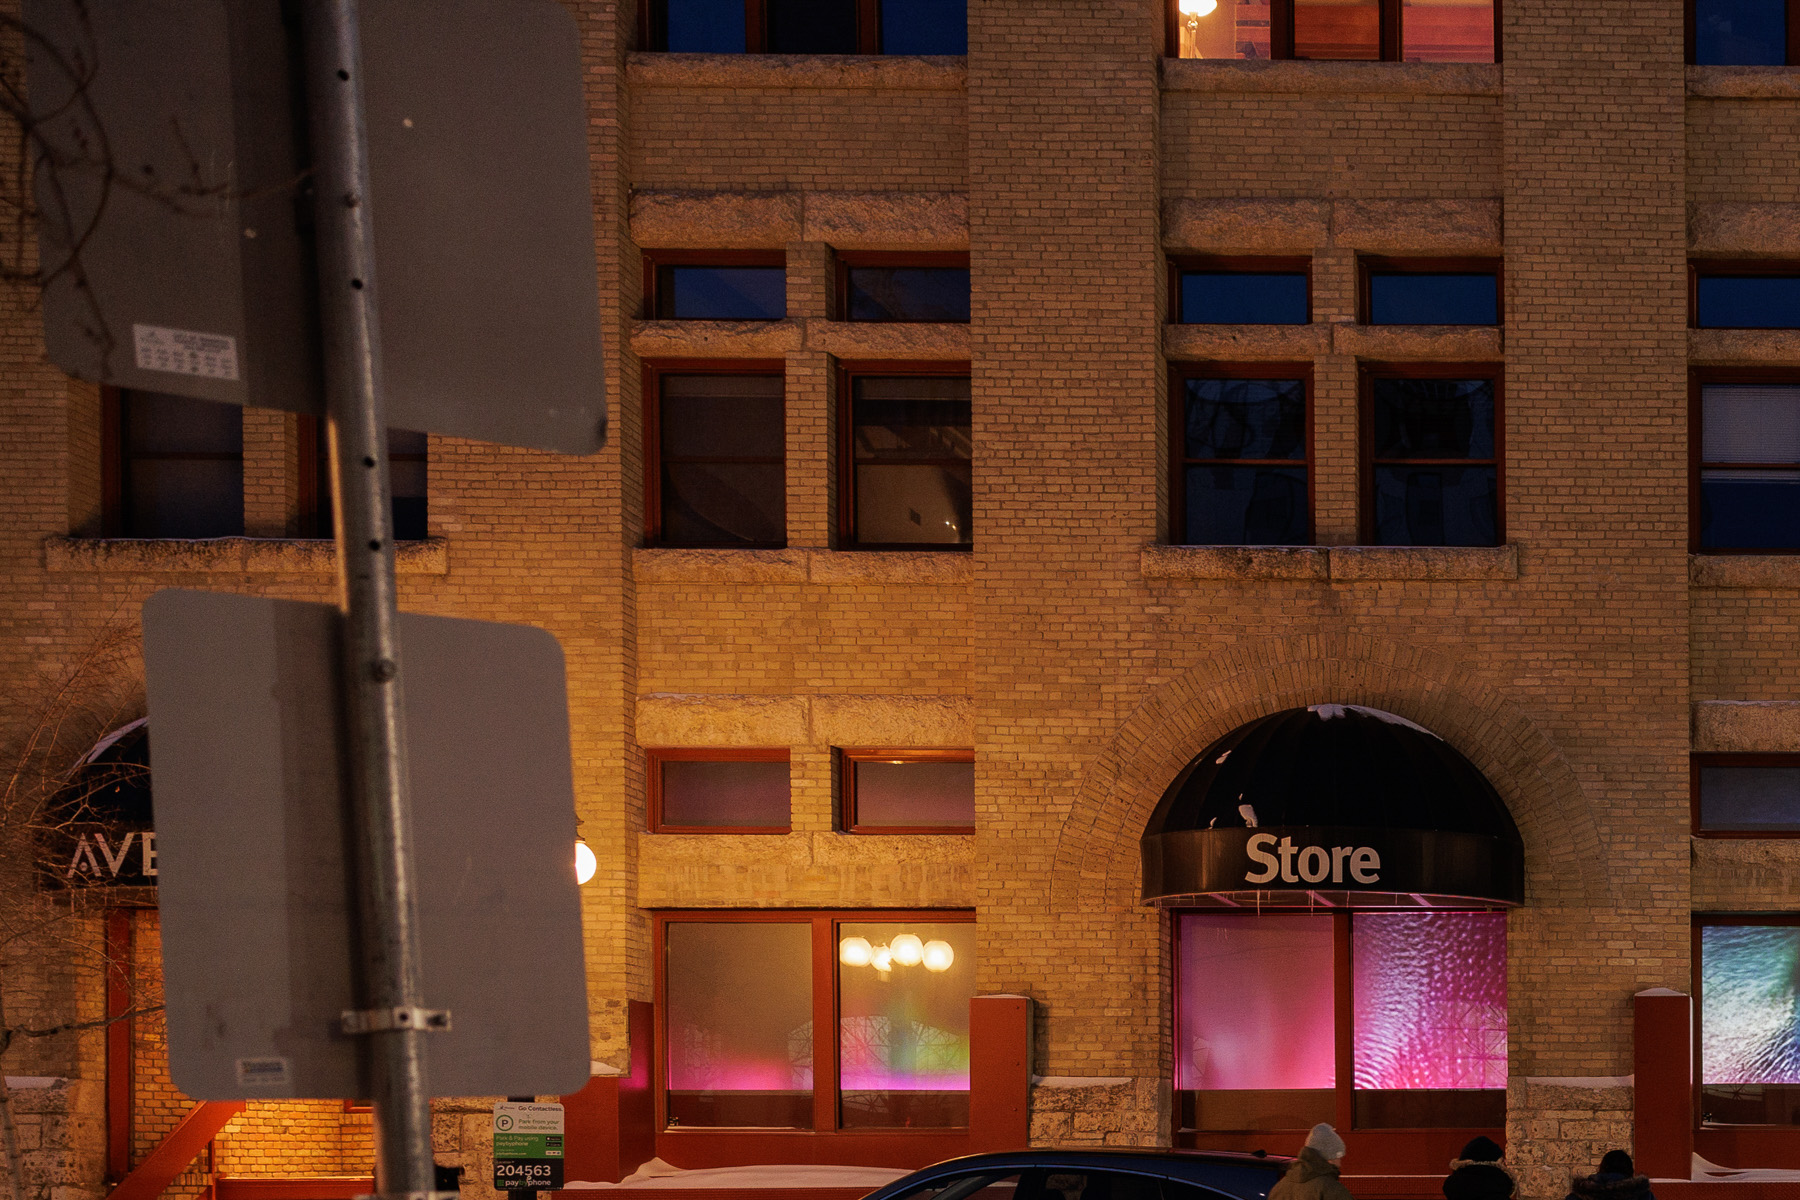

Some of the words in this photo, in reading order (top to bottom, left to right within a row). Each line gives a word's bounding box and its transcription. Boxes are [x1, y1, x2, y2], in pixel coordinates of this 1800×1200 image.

[1244, 832, 1381, 884] Store
[501, 1119, 509, 1127] P
[496, 1164, 551, 1176] 204563
